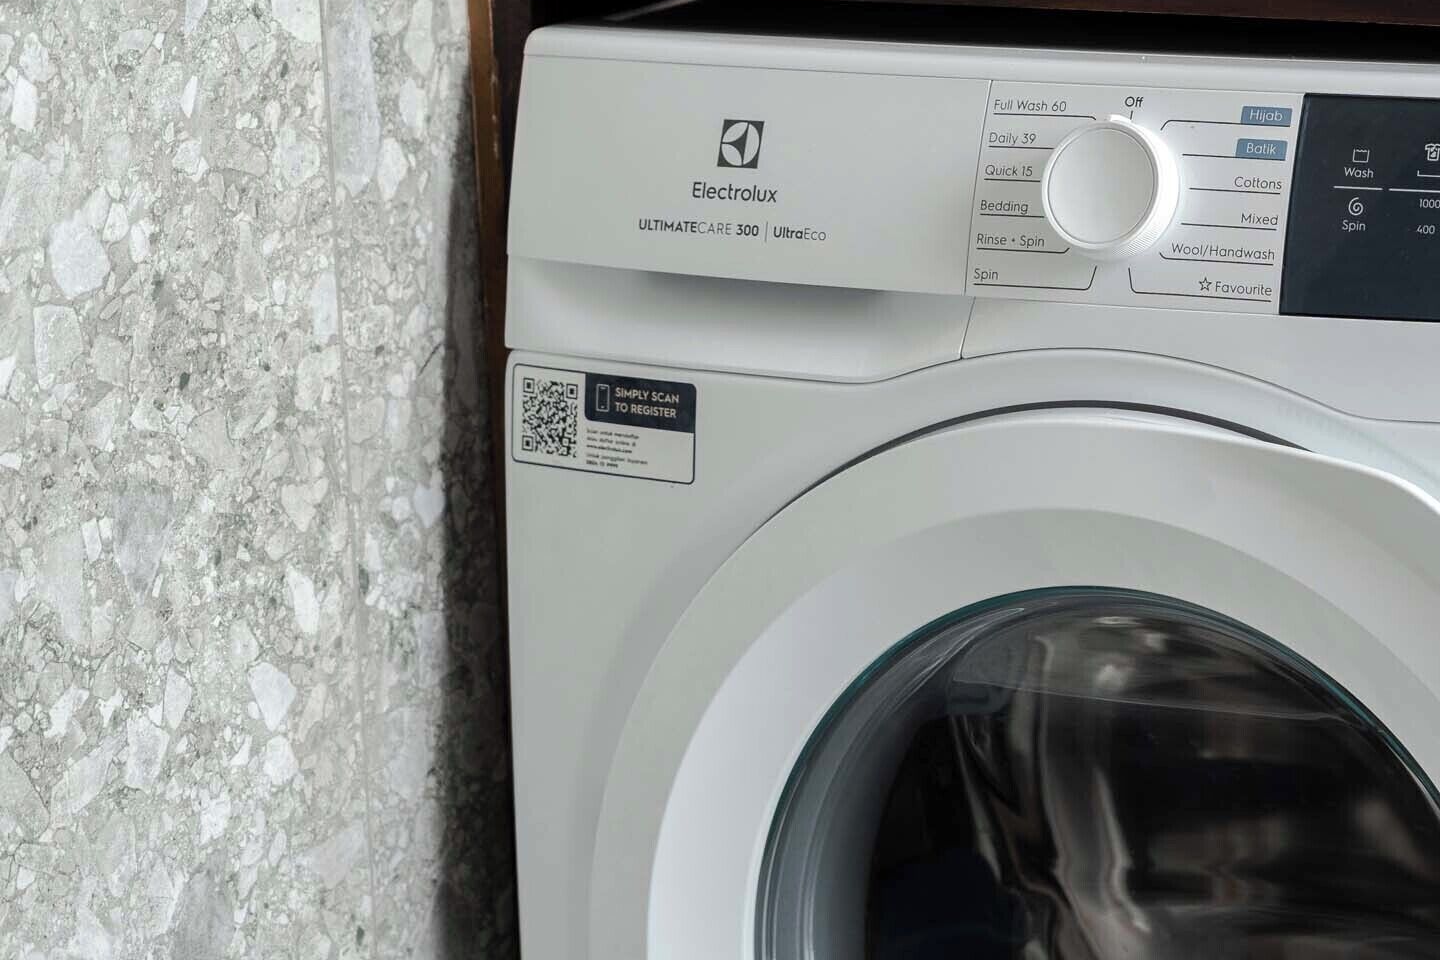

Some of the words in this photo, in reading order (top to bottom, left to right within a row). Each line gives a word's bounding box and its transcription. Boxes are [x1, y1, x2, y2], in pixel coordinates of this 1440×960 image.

[993, 99, 1014, 111] Full
[1015, 100, 1048, 112] Wash
[1051, 101, 1067, 113] 60
[1124, 96, 1144, 109] Off
[1249, 109, 1284, 124] Hijab
[988, 133, 1019, 146] Daily
[1022, 133, 1037, 145] 39
[1246, 142, 1277, 156] Batik
[984, 165, 1019, 177] Quick
[1022, 166, 1034, 177] 15
[1343, 167, 1374, 179] Wash
[1234, 177, 1283, 191] Cottons
[691, 181, 778, 204] Electrolux
[980, 200, 1029, 215] Bedding
[1240, 213, 1279, 227] Mixed
[1341, 220, 1366, 232] Spin
[638, 217, 733, 237] ULTIMATECARE
[735, 223, 760, 238] 300
[772, 225, 828, 242] UltraEco
[1416, 224, 1436, 235] 400
[976, 233, 1008, 246] Rinse
[1019, 234, 1045, 249] Spin
[1171, 242, 1276, 261] Wool/Handwash
[973, 268, 999, 282] Spin
[1215, 281, 1273, 297] Favourite
[614, 386, 651, 401] SIMPLY
[651, 391, 680, 404] SCAN
[614, 401, 629, 413] TO
[630, 403, 677, 419] REGISTER
